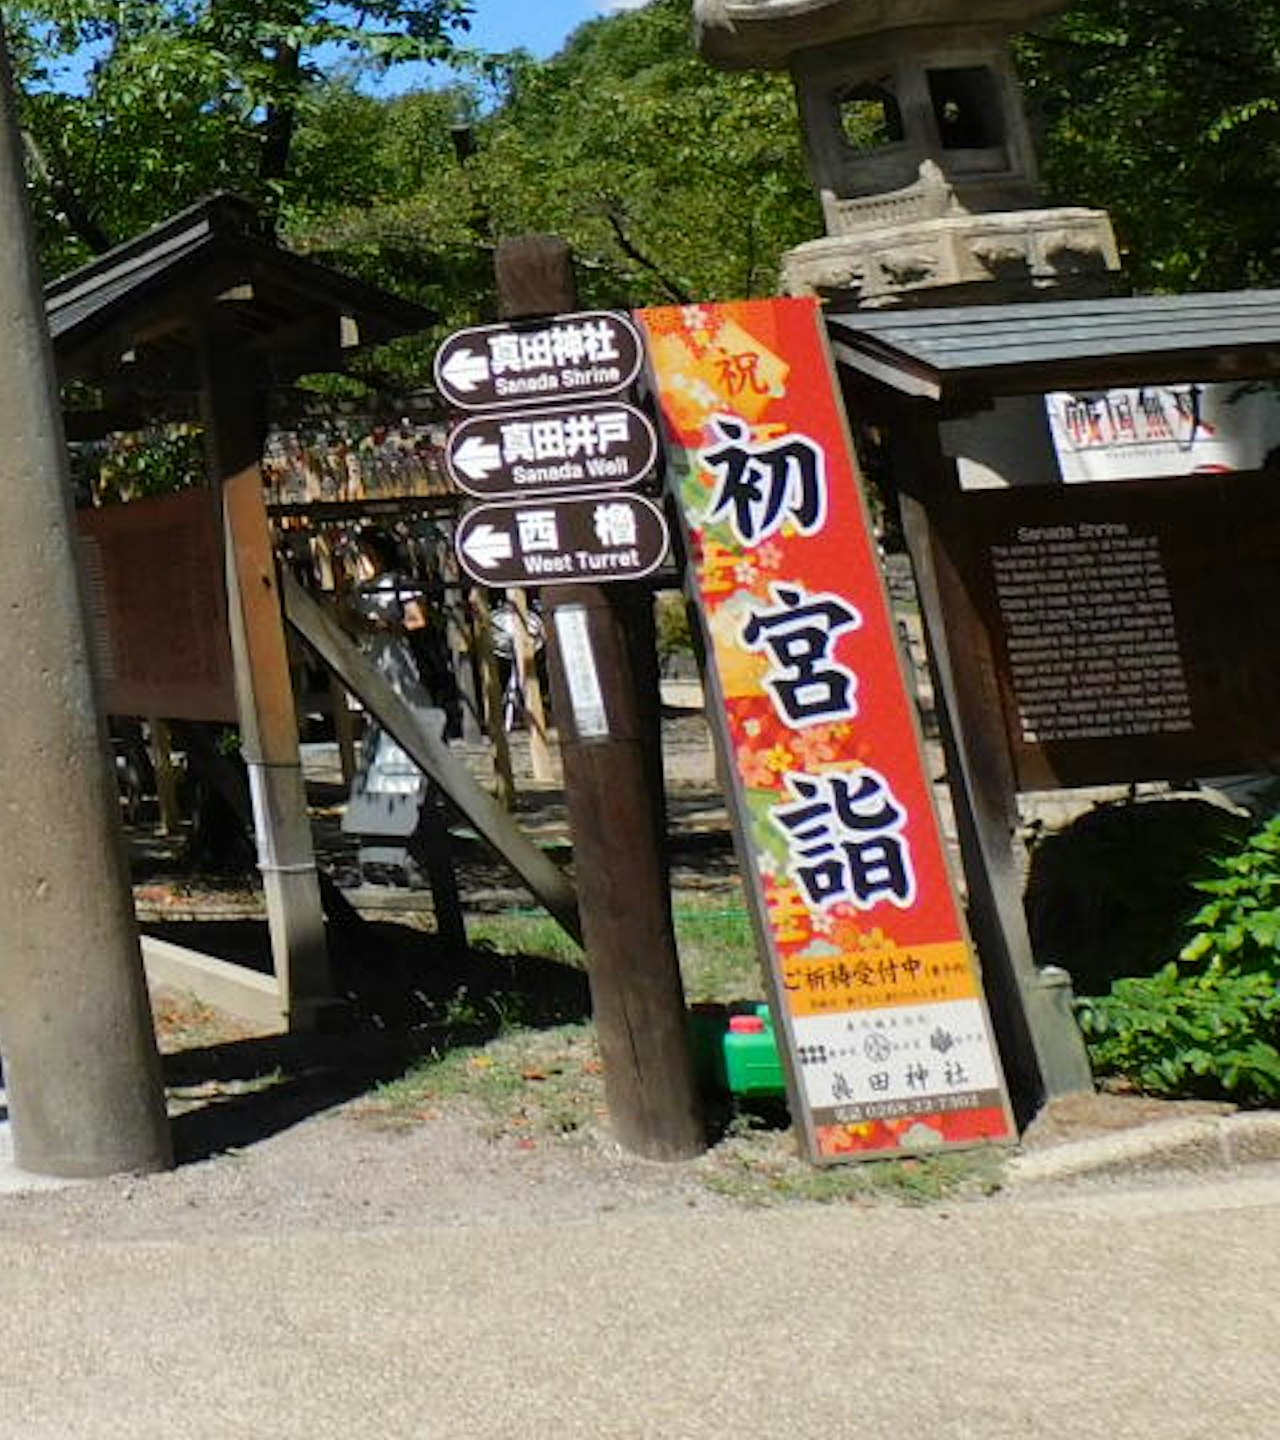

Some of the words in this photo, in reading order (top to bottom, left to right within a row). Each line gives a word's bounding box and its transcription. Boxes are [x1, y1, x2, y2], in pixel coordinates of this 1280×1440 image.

[487, 320, 620, 375] 真田神社
[713, 346, 770, 397] 祝
[495, 373, 558, 396] Sanada
[561, 366, 620, 388] Shrine
[500, 412, 630, 464] 真田井戸
[513, 461, 584, 484] Sanada
[585, 456, 630, 478] Well
[522, 551, 574, 575] West
[574, 548, 641, 570] Turret
[704, 421, 912, 907] 初宮詣
